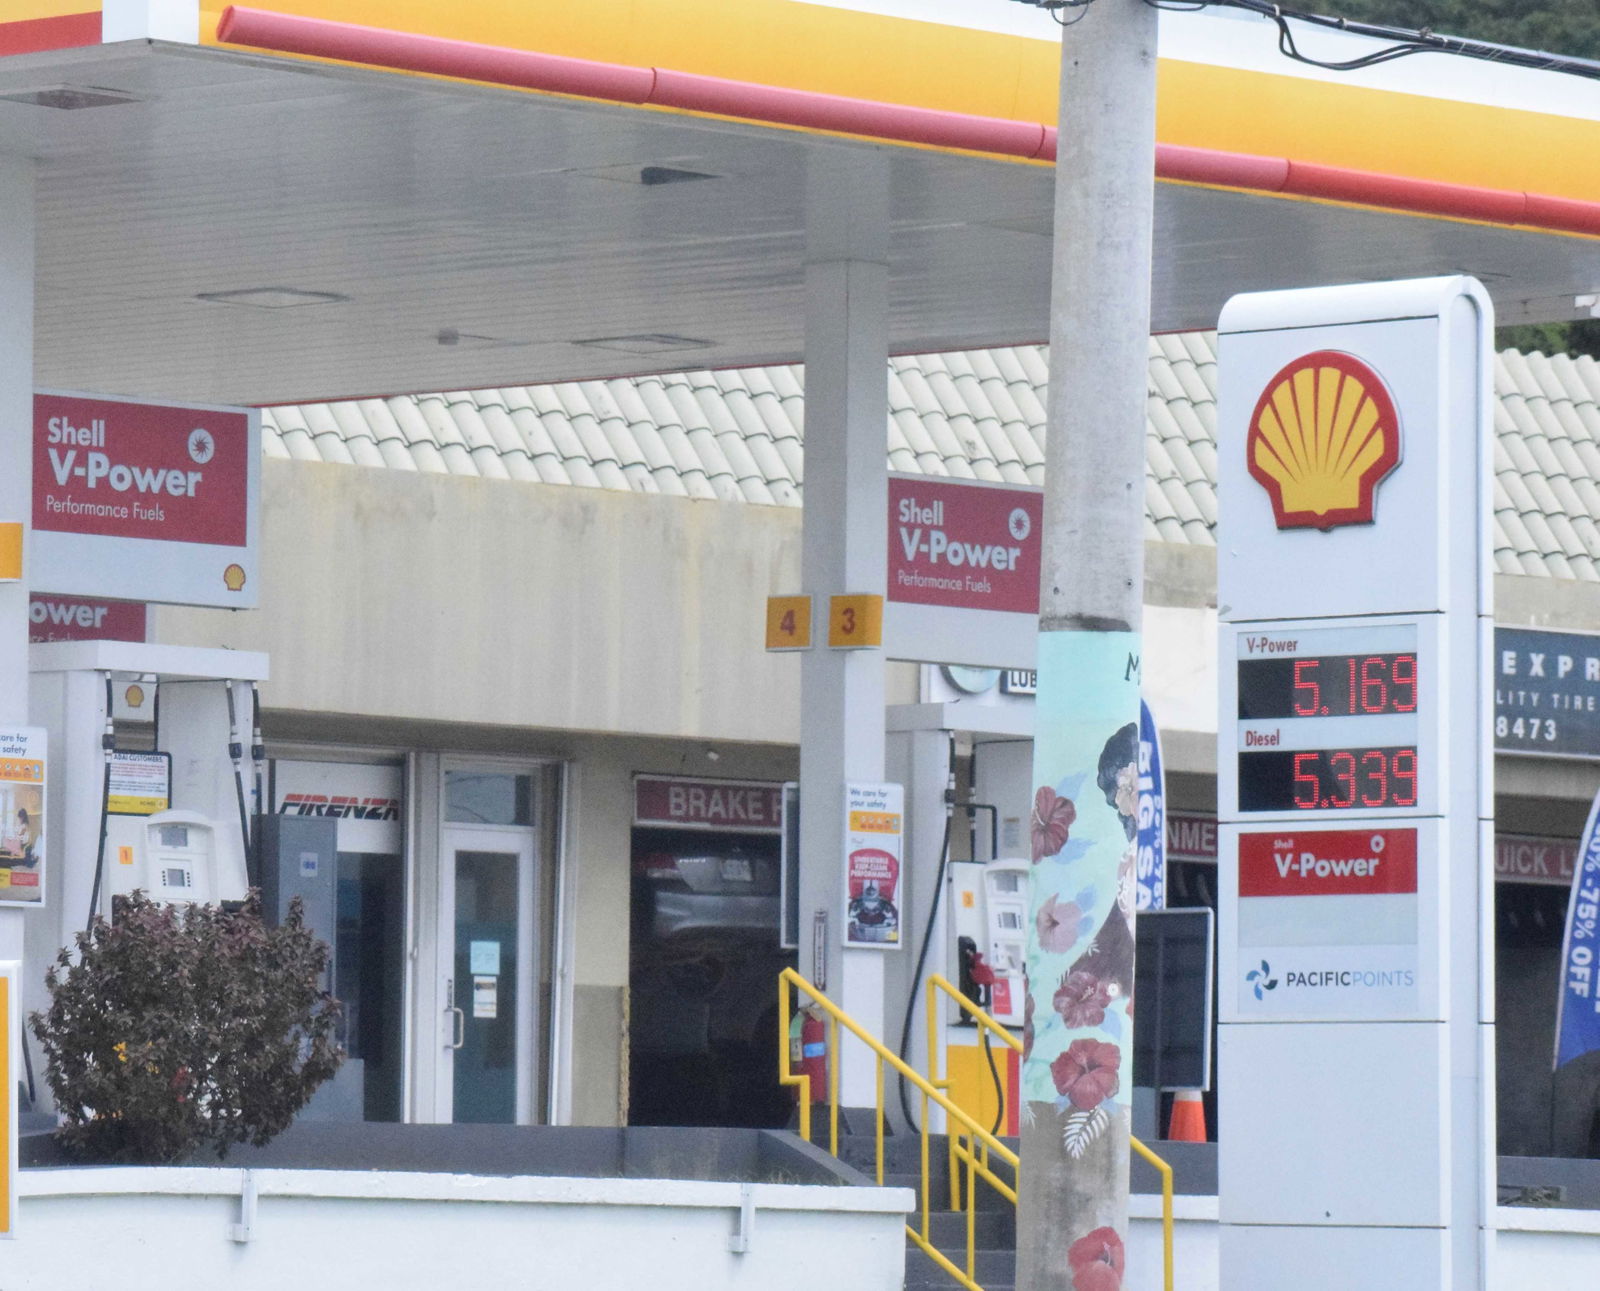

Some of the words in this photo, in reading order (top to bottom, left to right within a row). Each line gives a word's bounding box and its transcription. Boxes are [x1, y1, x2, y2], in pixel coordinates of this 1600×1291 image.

[48, 417, 105, 447] Shell
[48, 448, 202, 497] V-Power
[46, 495, 128, 519] Performance
[133, 502, 165, 521] Fuels
[898, 497, 944, 527] Shell
[899, 526, 1021, 571] V-Power
[897, 570, 963, 590] Performance
[965, 576, 992, 594] Fuels
[780, 609, 796, 636] 4
[842, 607, 855, 635] 3
[1247, 637, 1298, 653] V-Power
[1502, 650, 1600, 681] EXPR
[1294, 655, 1417, 716] 5.169
[1552, 693, 1595, 712] TIRE
[1245, 728, 1280, 746] Diesel
[1495, 716, 1557, 741] 8473
[2, 744, 27, 757] safety
[1294, 750, 1417, 808] 5.339
[279, 793, 400, 821] FIRENZA
[669, 786, 764, 822] BRAKE
[1273, 839, 1294, 849] Shell
[1273, 852, 1379, 878] V-Power
[1569, 945, 1594, 999] OFF
